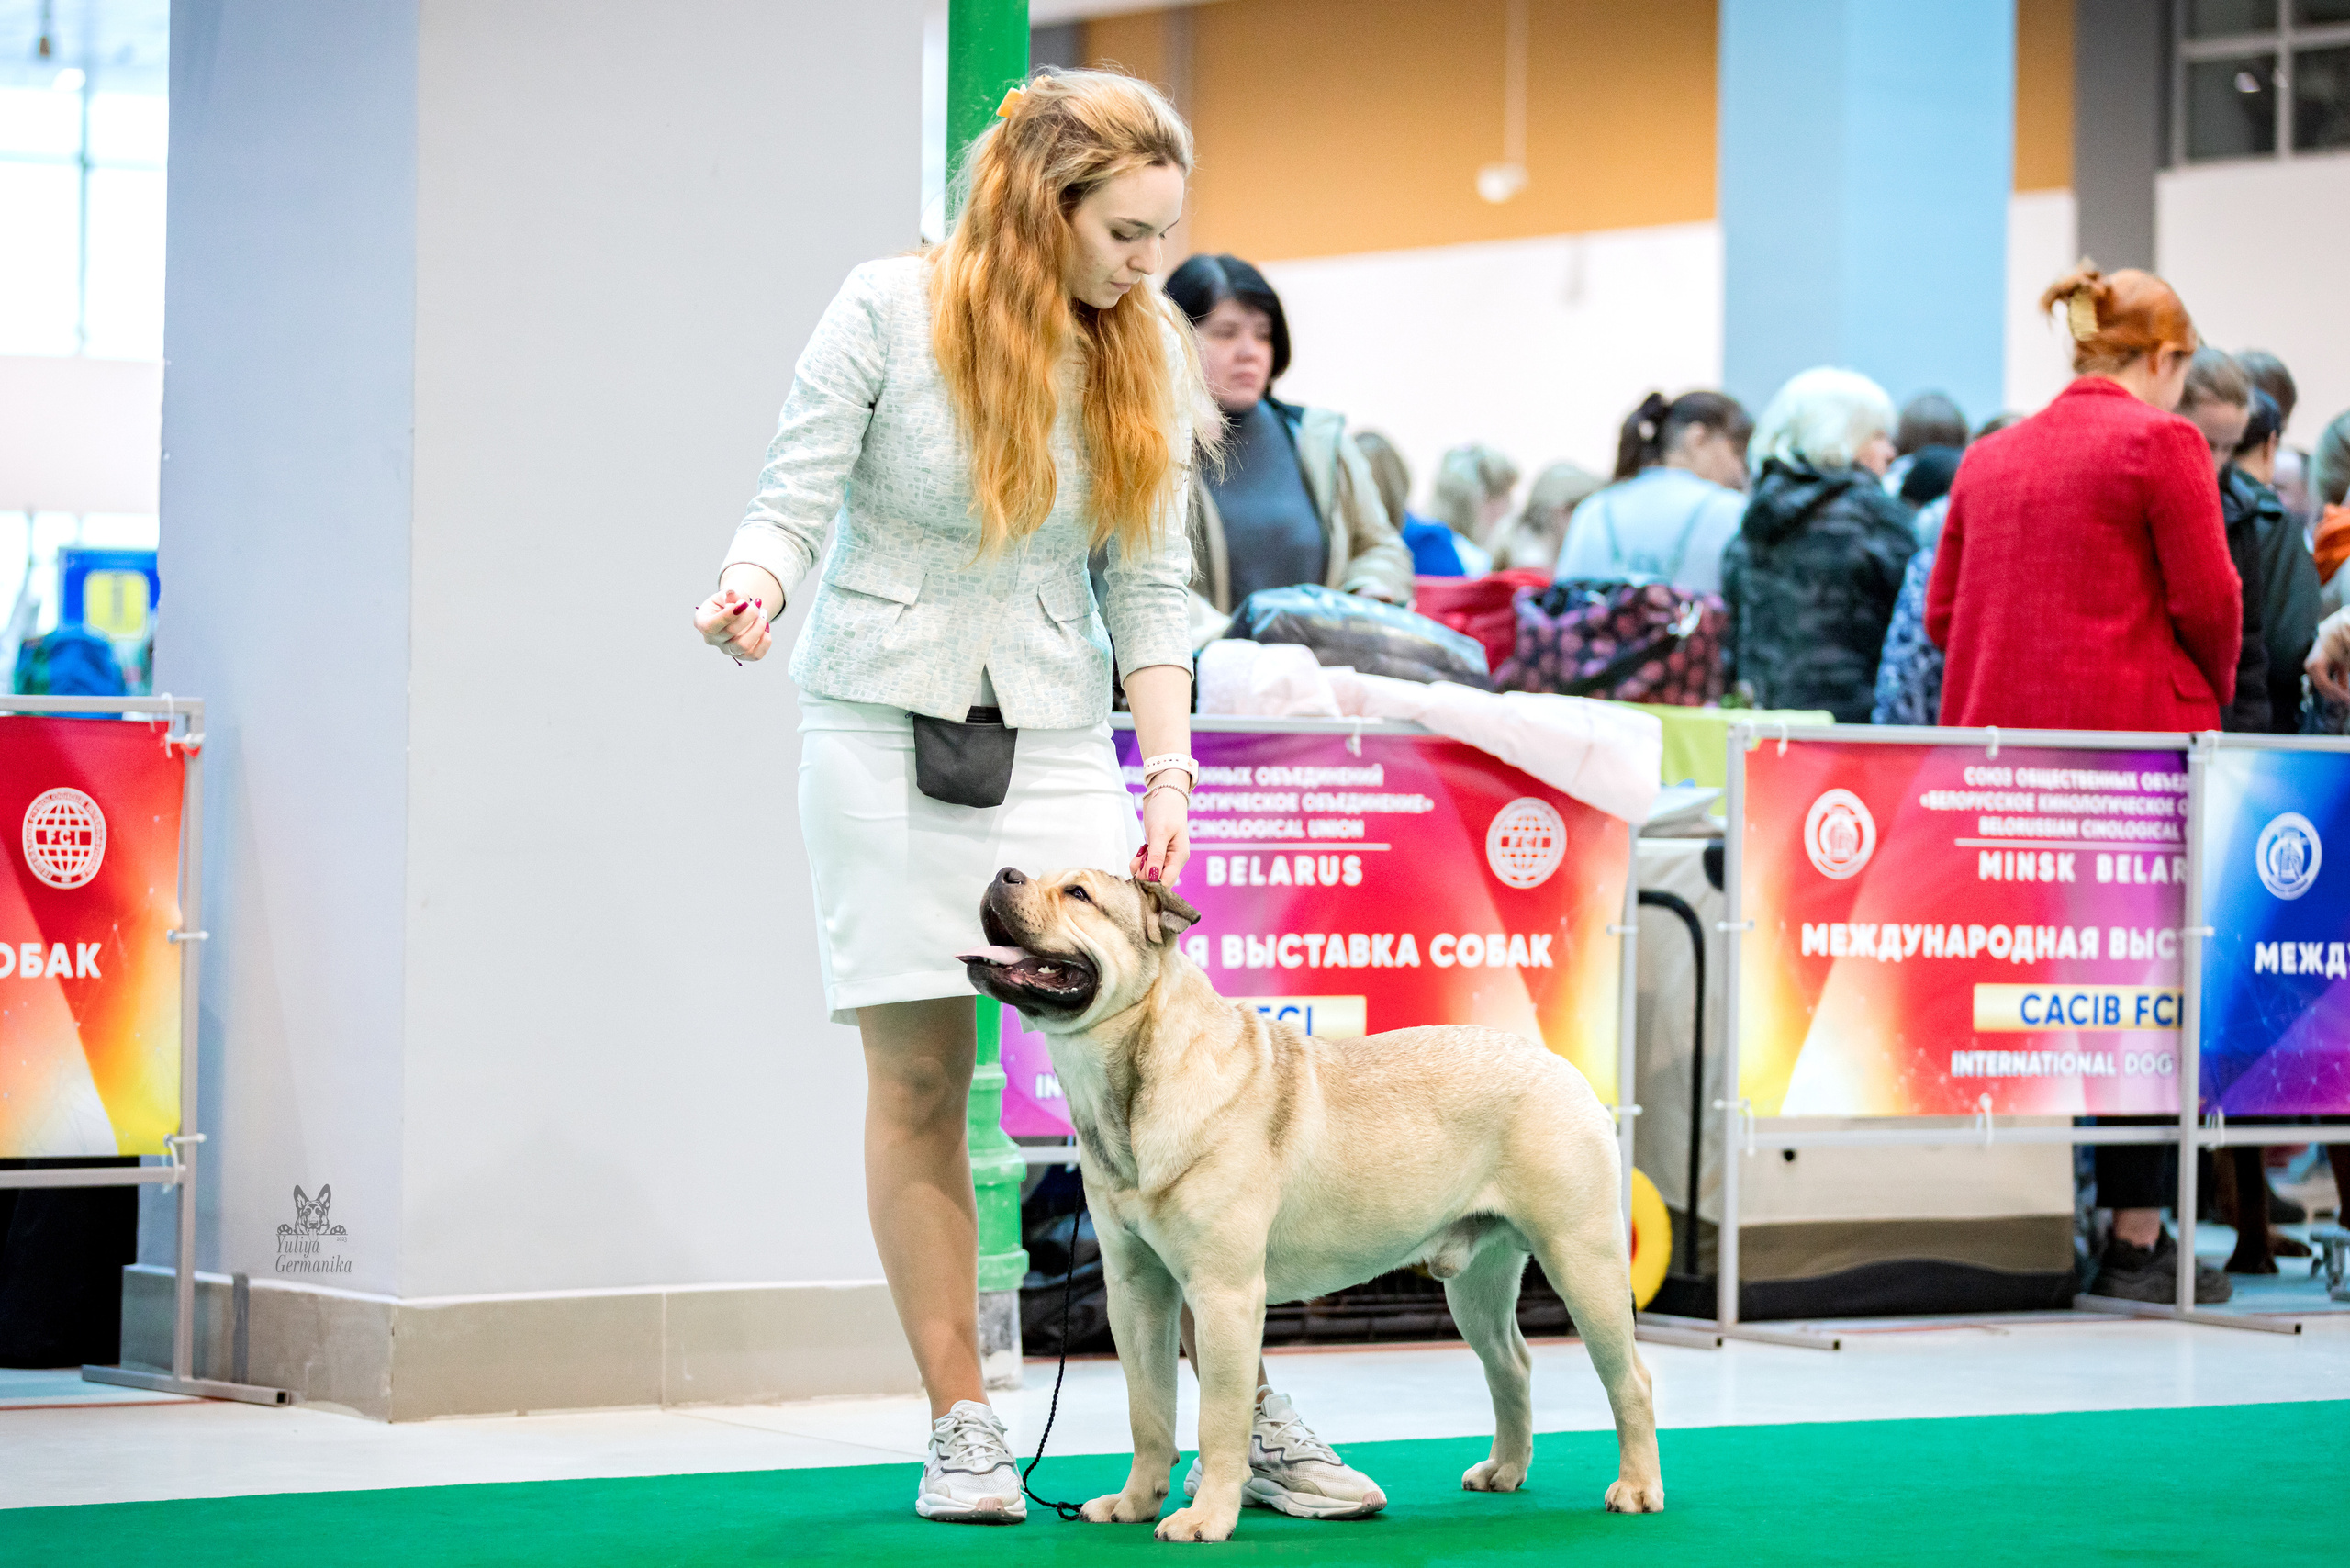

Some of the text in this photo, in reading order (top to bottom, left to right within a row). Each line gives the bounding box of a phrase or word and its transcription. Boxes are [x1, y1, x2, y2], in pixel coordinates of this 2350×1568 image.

[1964, 766, 2013, 787] СОЮЗ
[2015, 767, 2139, 791] ОБЩЕСТВЕННЫХ
[2038, 792, 2176, 816] КИНОЛОГИЧЕСКОЕ
[46, 829, 81, 846] FCI
[1307, 819, 1365, 838] UNION
[1978, 816, 2180, 840] BELORUSSIAN CINOLOGICAL
[1206, 855, 1363, 887] BELARUS
[1978, 850, 2076, 883] MINSK
[1221, 934, 1421, 969] ВЫСТАВКА
[1429, 933, 1553, 969] СОБАК
[1801, 924, 2100, 964] МЕЖДУНАРОДНАЯ
[2254, 941, 2350, 980] МЕЖД
[2020, 993, 2184, 1028] CACIB FCI
[1951, 1050, 2174, 1078] INTERNATIONAL DOG
